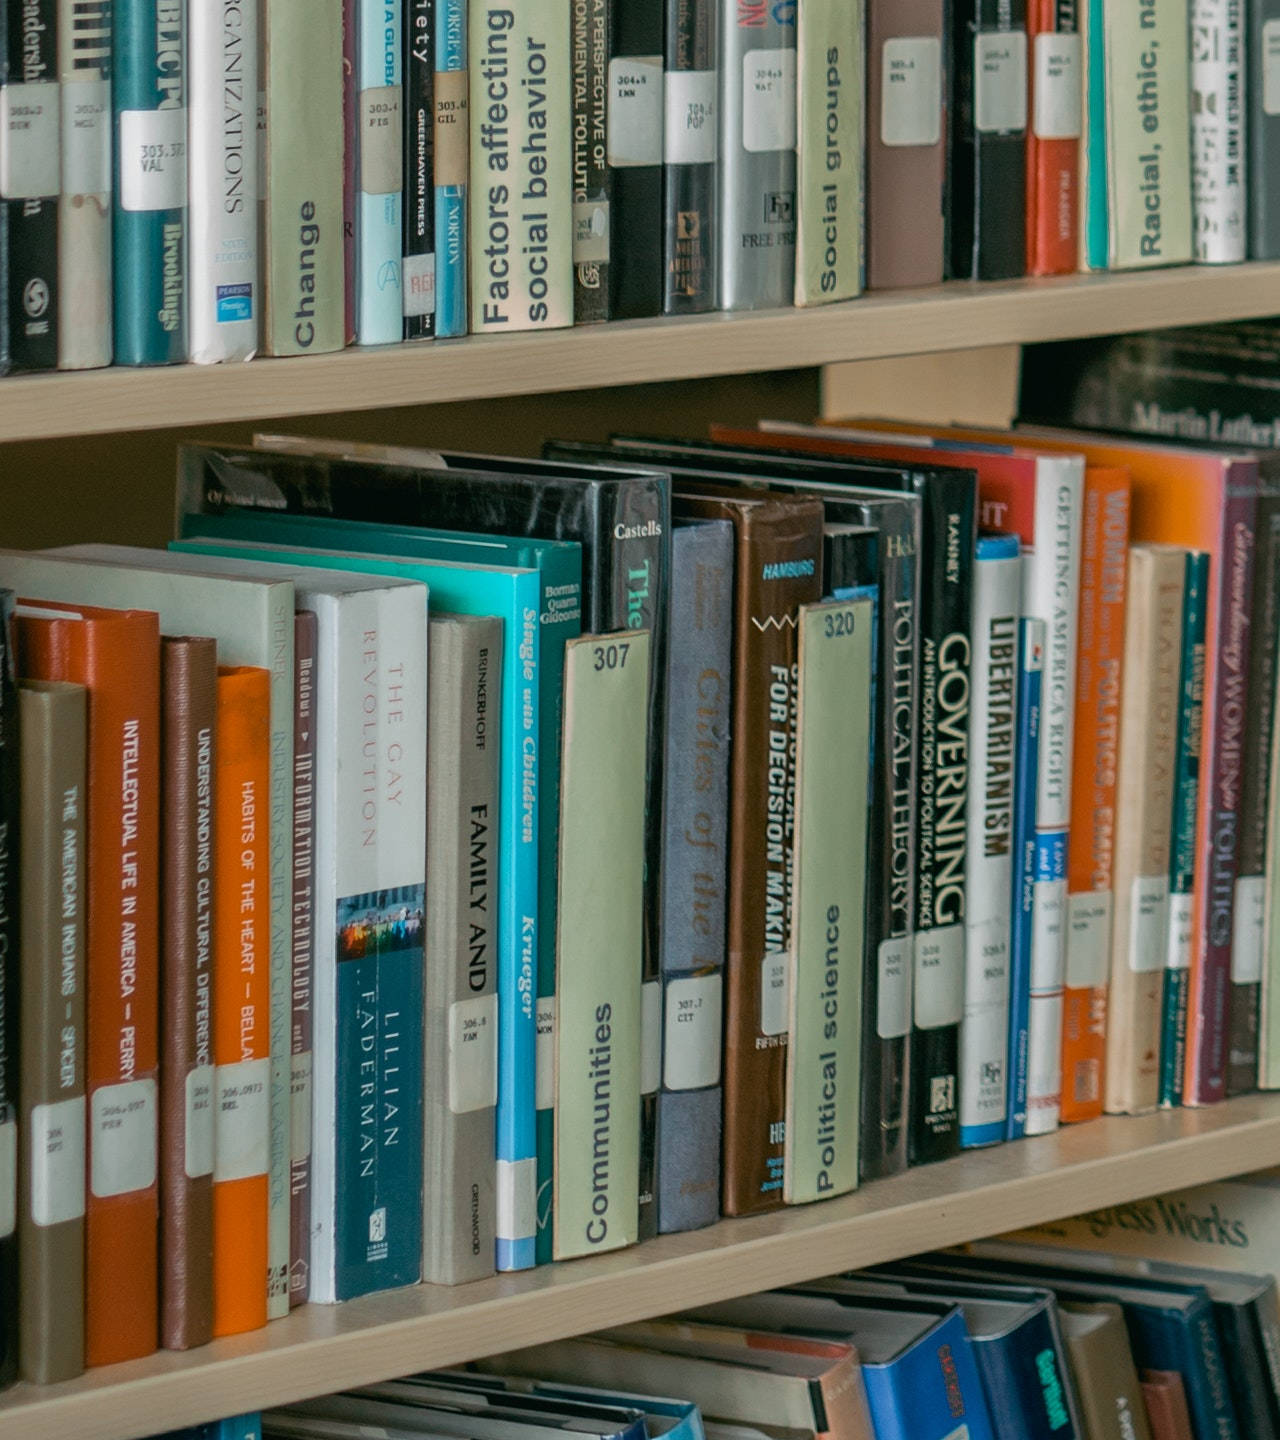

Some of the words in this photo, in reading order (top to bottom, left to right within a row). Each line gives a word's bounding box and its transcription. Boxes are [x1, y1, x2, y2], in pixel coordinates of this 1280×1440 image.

[483, 7, 516, 166] affecting
[524, 35, 549, 195] behavior
[823, 47, 841, 183] groups
[1138, 37, 1162, 133] ethic,
[481, 164, 509, 326] Factors
[527, 203, 550, 323] social
[821, 193, 838, 292] Social
[1139, 137, 1164, 258] Racial,
[294, 200, 319, 349] Change
[614, 522, 662, 540] Castells
[592, 645, 630, 671] 307
[824, 614, 855, 638] 320
[936, 632, 972, 924] GOVERNING
[984, 616, 1015, 859] LIBERTARIANISM
[471, 804, 490, 915] FAMILY
[468, 924, 488, 994] AND
[822, 904, 840, 1041] science
[585, 1002, 614, 1245] Communities
[816, 1054, 838, 1192] Political
